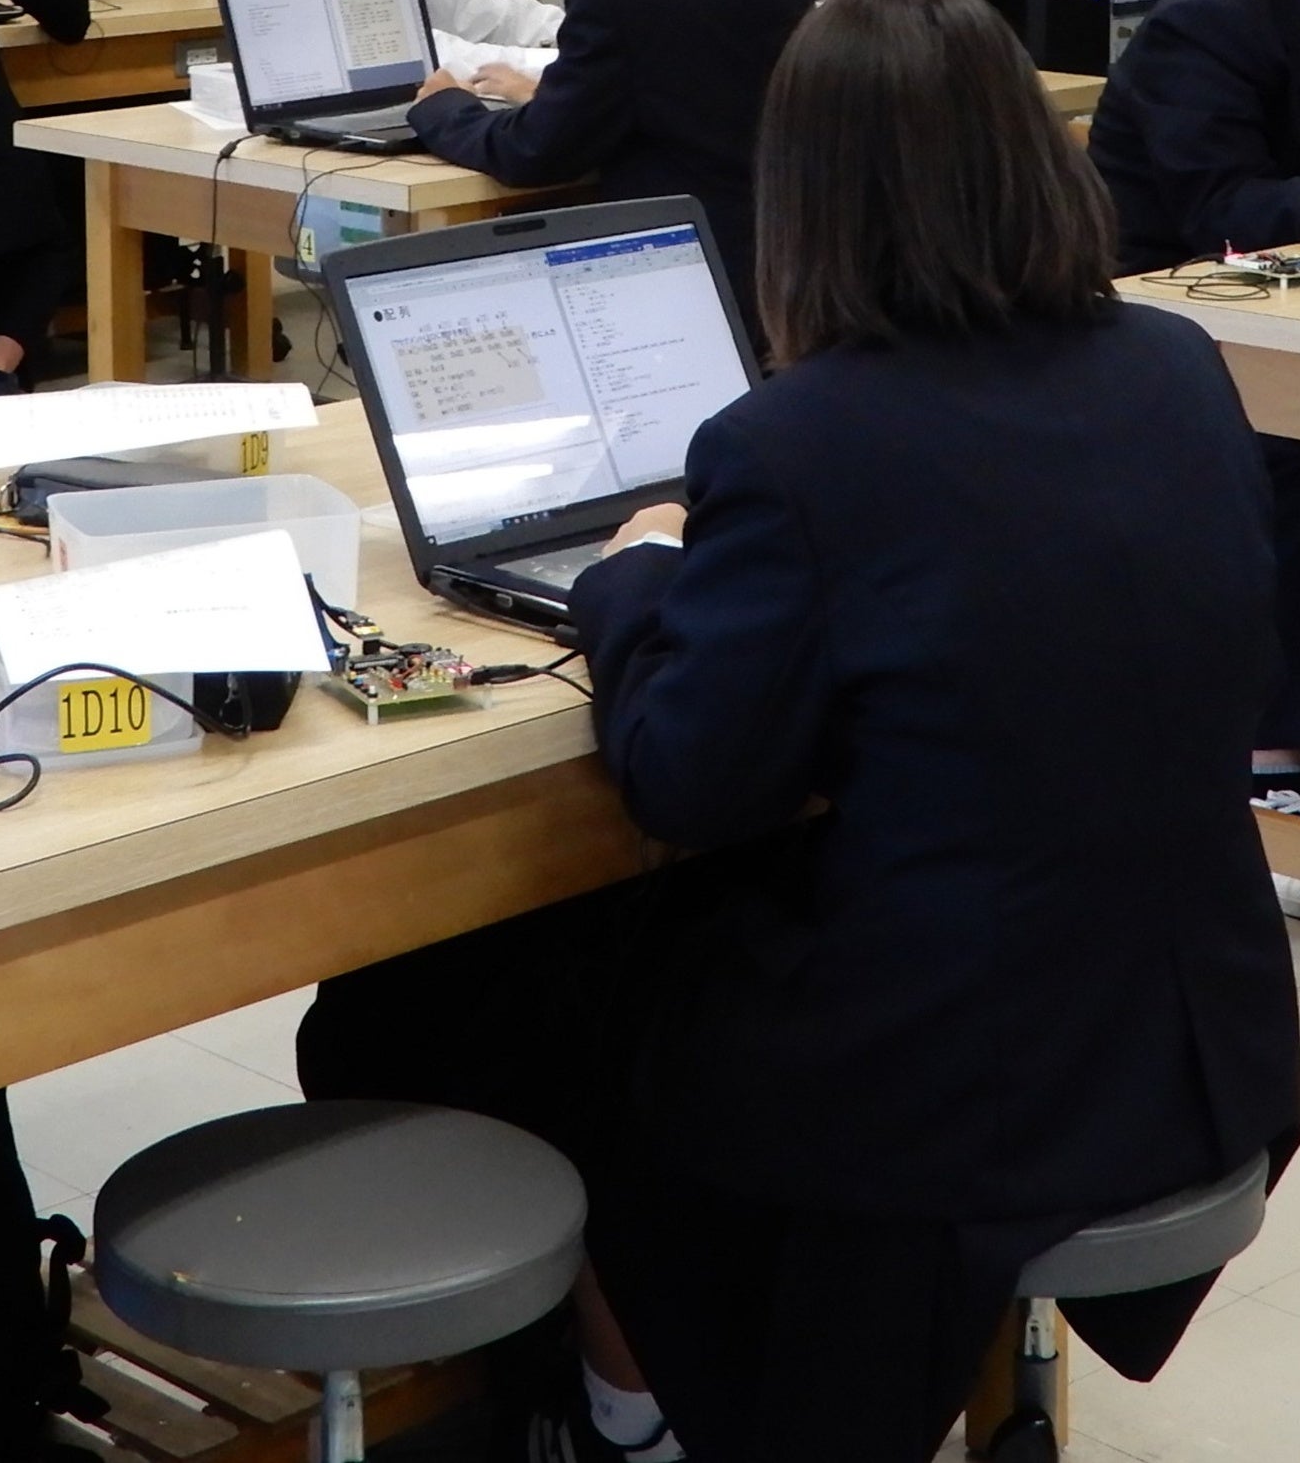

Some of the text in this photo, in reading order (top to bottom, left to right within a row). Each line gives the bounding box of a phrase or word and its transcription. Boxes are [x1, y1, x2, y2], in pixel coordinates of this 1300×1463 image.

[302, 232, 313, 256] 4
[382, 305, 412, 322] 配列
[241, 430, 269, 473] 1D9
[62, 684, 146, 740] 1D10
